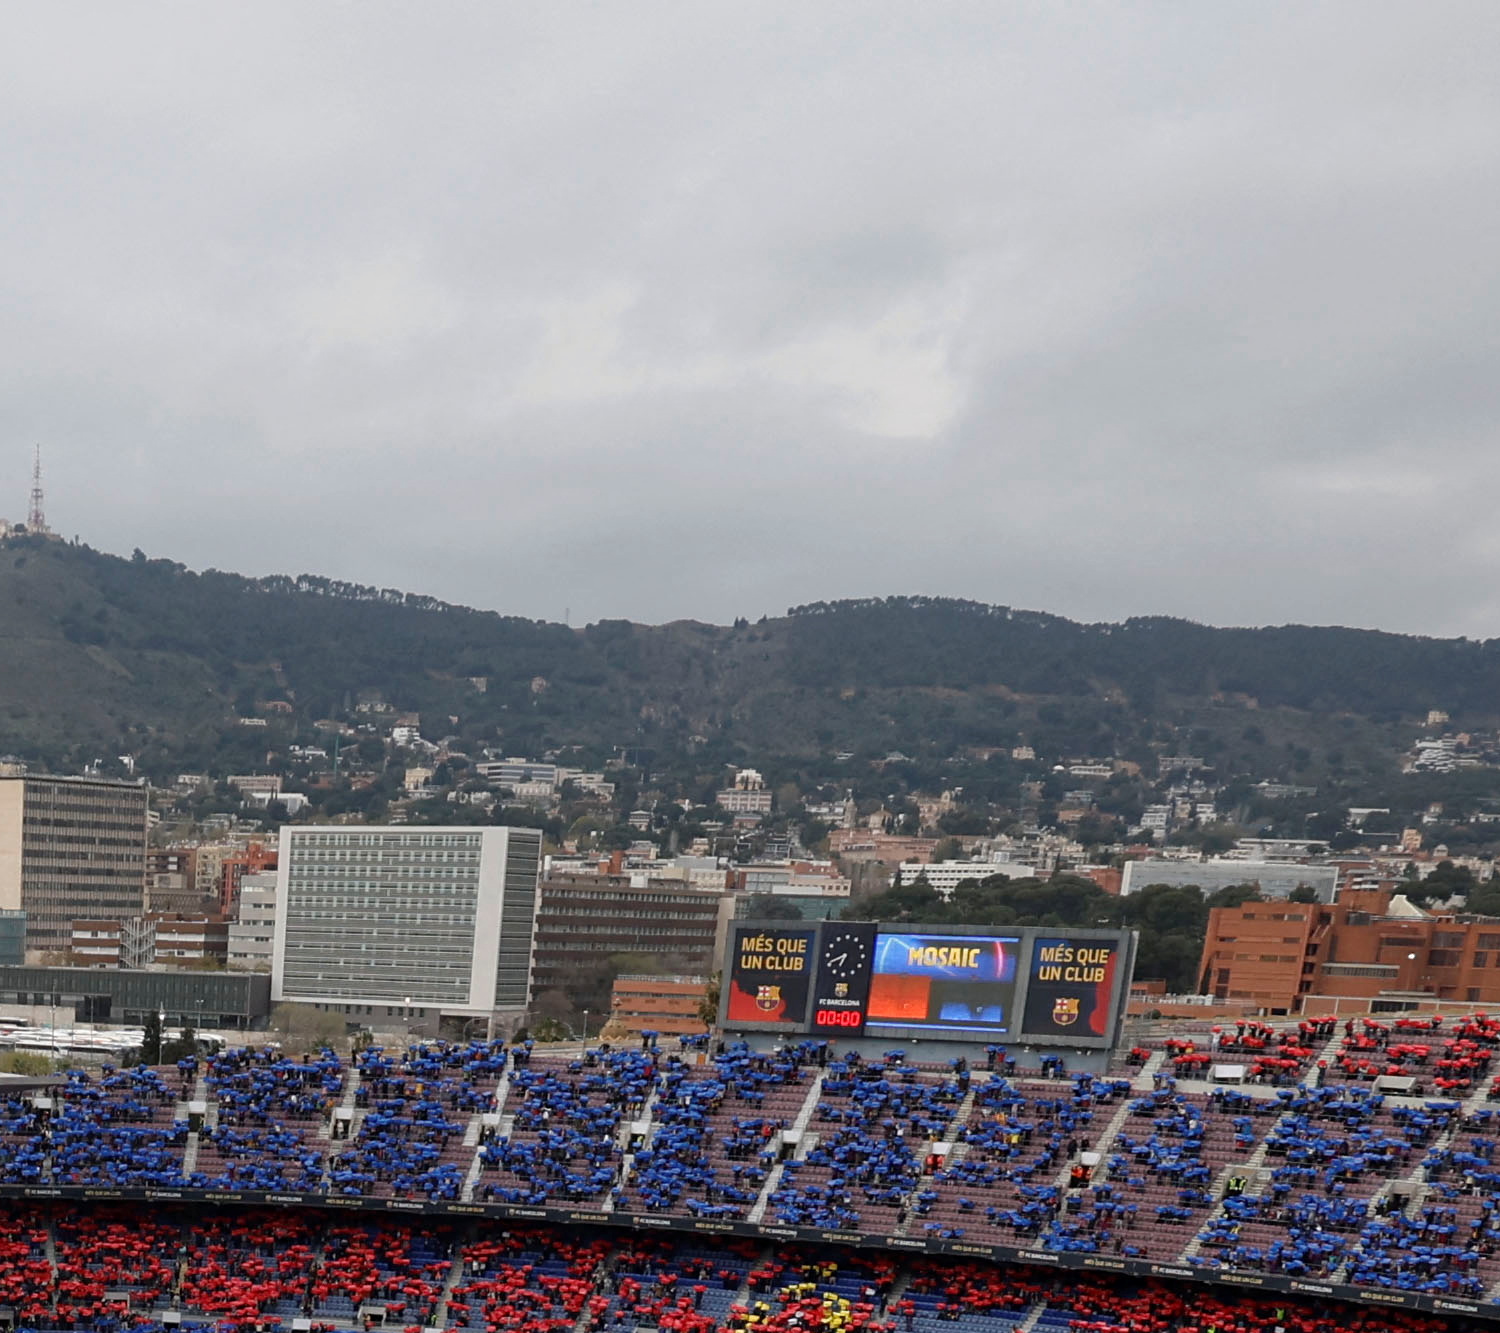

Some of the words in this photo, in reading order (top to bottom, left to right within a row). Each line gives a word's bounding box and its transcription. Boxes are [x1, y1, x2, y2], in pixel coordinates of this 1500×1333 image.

[741, 934, 773, 953] MÉS
[776, 937, 807, 955] QUE
[741, 954, 763, 969] UN
[766, 955, 803, 972] CLUB
[908, 947, 981, 969] MOSAIC
[1040, 943, 1073, 963] MÉS
[1077, 947, 1110, 965] QUE
[1039, 966, 1062, 981] UN
[1065, 967, 1104, 984] CLUB
[819, 998, 828, 1006] FC
[828, 999, 860, 1007] BARCELONA
[817, 1011, 860, 1027] 00:00
